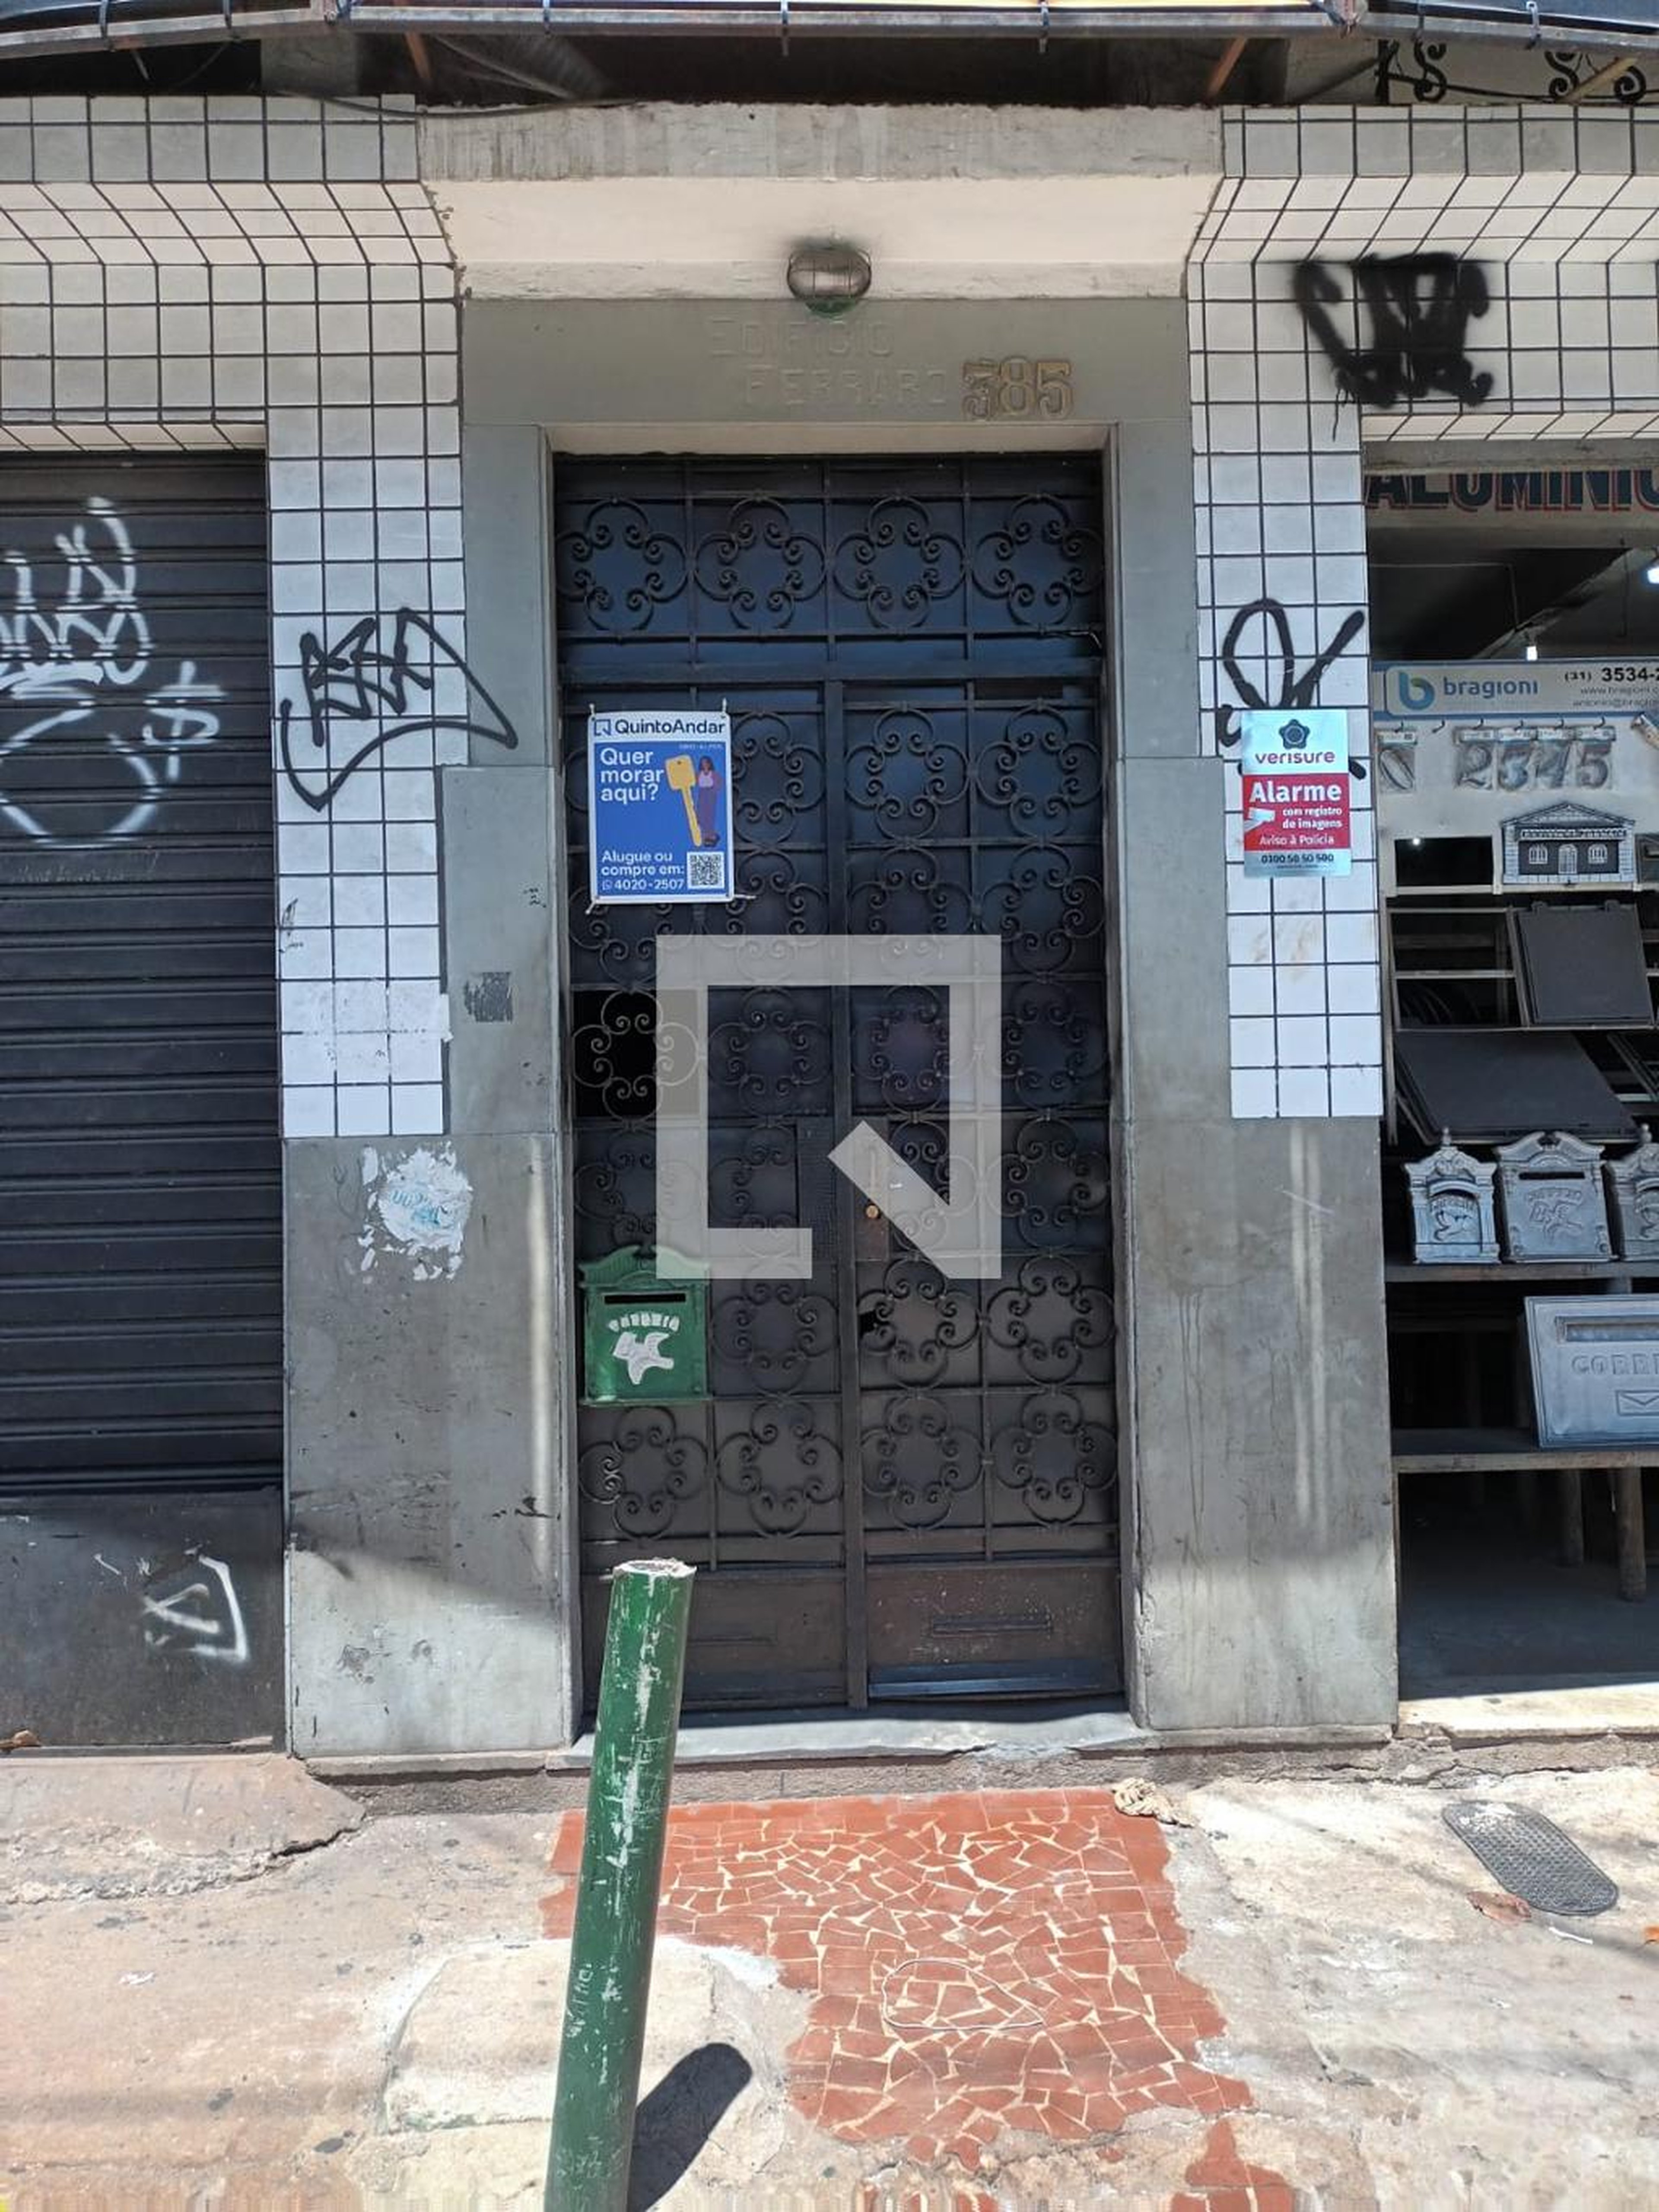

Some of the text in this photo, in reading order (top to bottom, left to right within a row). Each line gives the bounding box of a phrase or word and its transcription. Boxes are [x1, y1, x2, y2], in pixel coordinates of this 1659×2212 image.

[960, 356, 1076, 420] 385
[1564, 671, 1592, 681] (31)
[1443, 676, 1538, 699] bragioni
[615, 719, 725, 734] QuintoAndar
[600, 748, 654, 765] Quer
[1255, 751, 1335, 764] verisure
[600, 768, 664, 783] morar
[601, 783, 658, 805] aqui?
[1249, 781, 1342, 803] Alarme
[1304, 805, 1342, 817] registro
[1283, 818, 1343, 831] de imagens
[1260, 834, 1287, 845] Aviso
[602, 850, 673, 865] Alugue ou
[601, 865, 685, 878] compre em:
